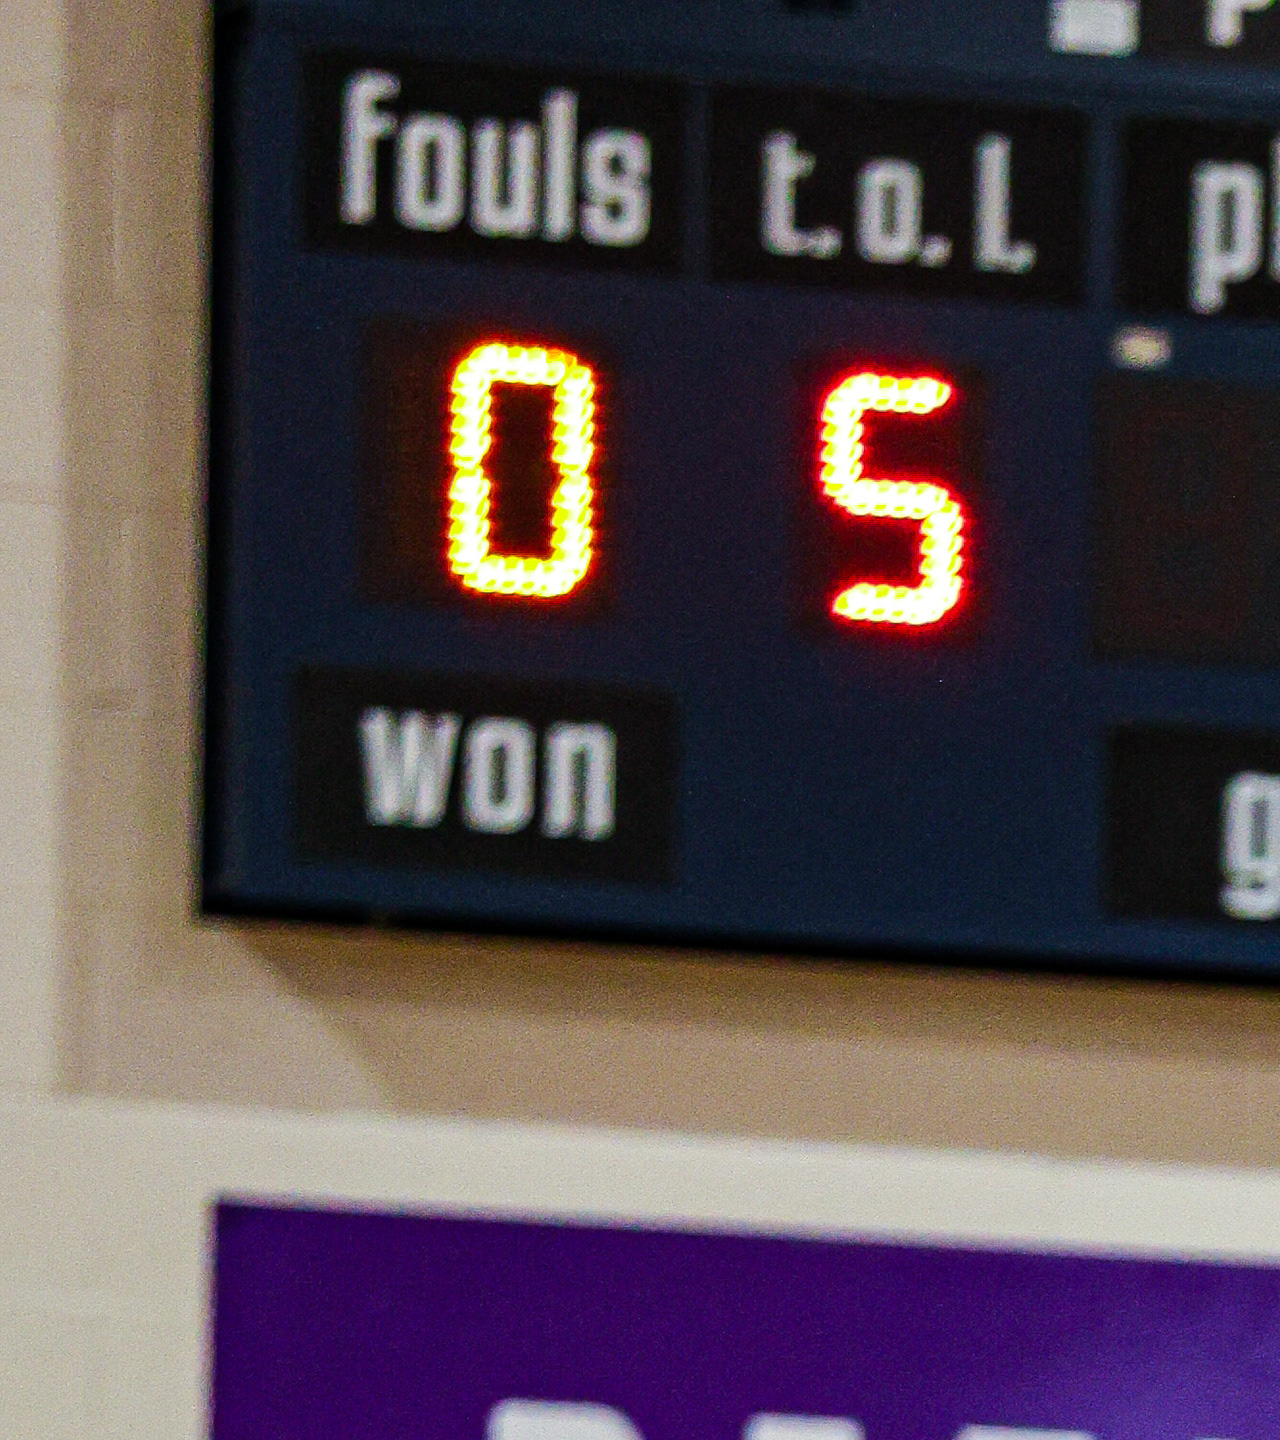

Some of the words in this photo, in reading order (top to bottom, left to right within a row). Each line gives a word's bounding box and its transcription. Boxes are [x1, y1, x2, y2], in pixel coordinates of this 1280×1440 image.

[348, 77, 645, 242] fouls
[448, 343, 595, 597] 0
[820, 373, 963, 625] 5
[365, 714, 611, 833] won
